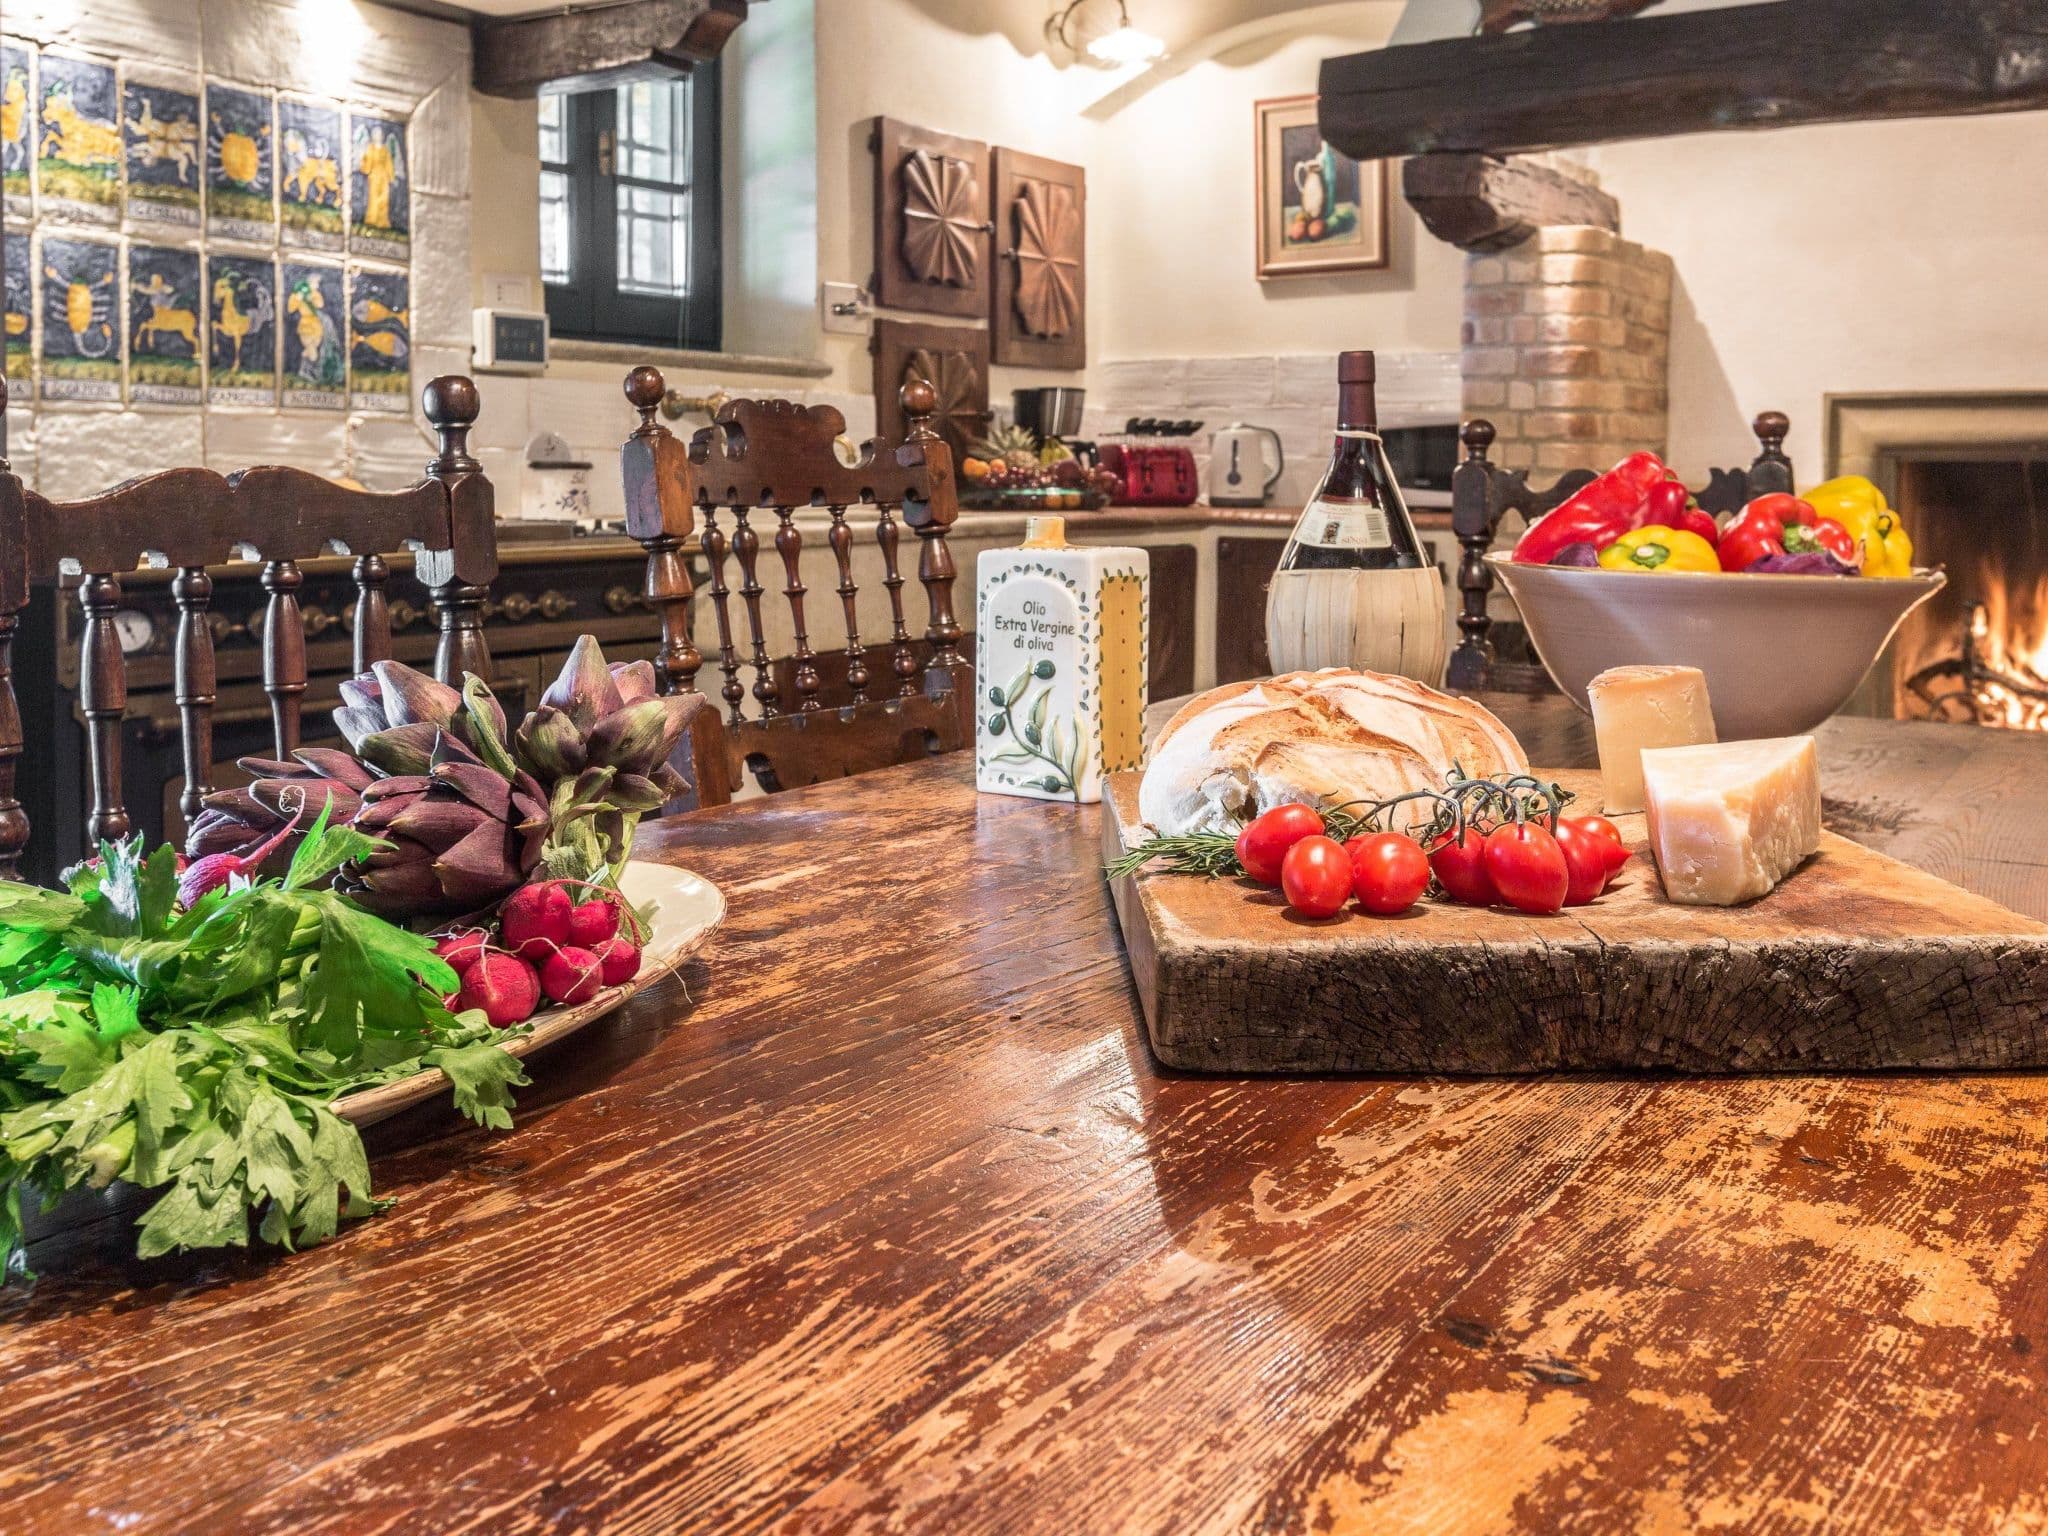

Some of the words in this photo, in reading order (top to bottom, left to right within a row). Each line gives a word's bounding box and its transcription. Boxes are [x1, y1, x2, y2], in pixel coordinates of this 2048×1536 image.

[1023, 601, 1046, 616] Olio
[995, 616, 1027, 632] Extra
[1031, 619, 1075, 638] Vergine
[1013, 634, 1024, 649] di
[1027, 637, 1054, 651] oliva
